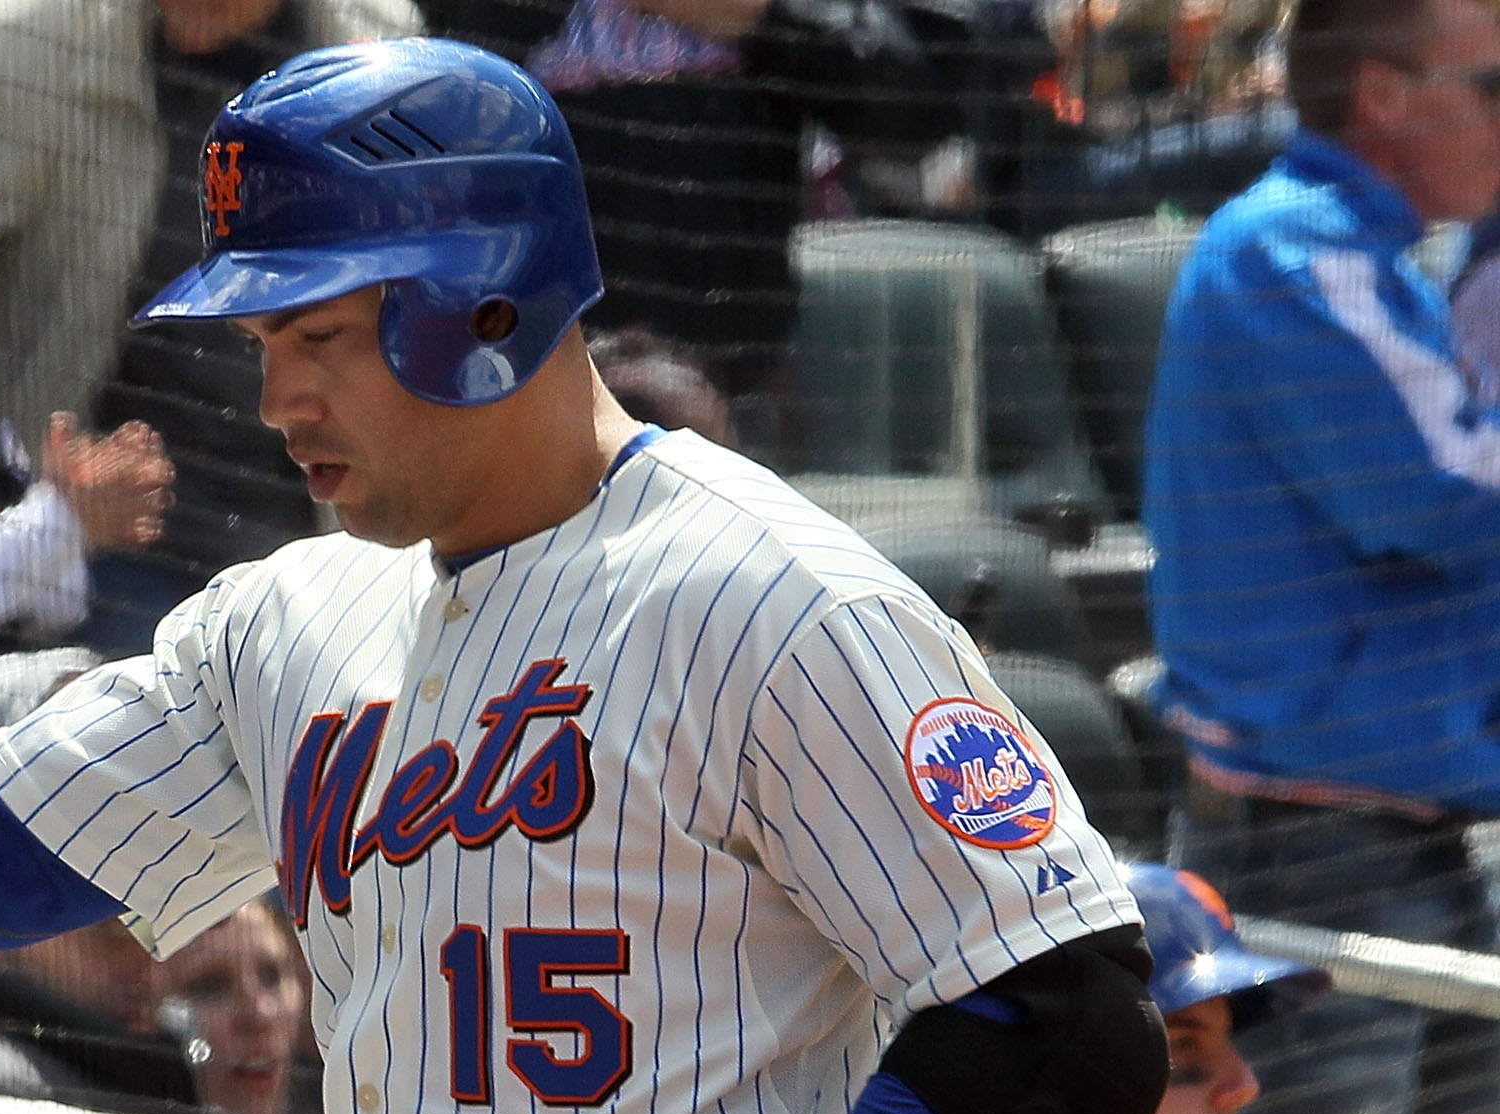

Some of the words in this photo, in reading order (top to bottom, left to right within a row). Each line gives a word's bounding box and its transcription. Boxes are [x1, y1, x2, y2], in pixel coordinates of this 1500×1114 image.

[205, 142, 244, 236] NY
[275, 657, 596, 930] Mets
[953, 747, 1032, 813] Mets
[440, 923, 633, 1107] 15
